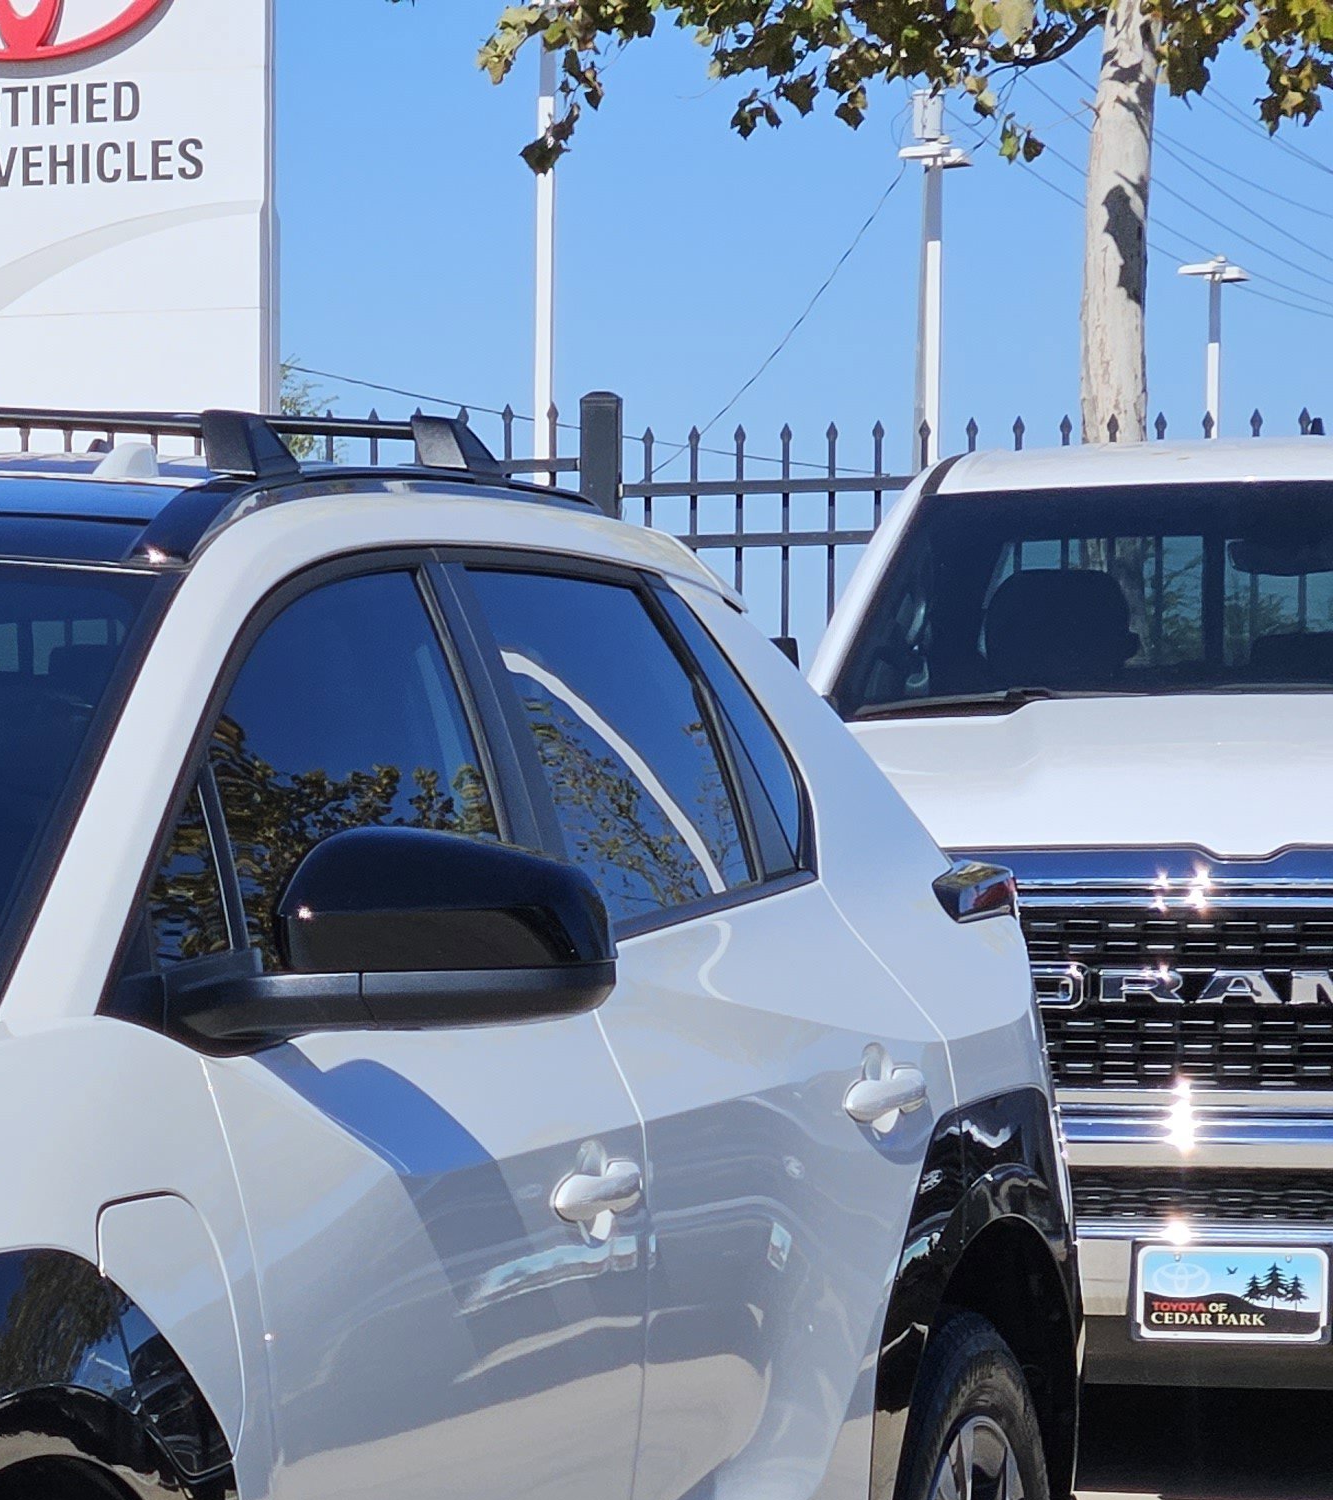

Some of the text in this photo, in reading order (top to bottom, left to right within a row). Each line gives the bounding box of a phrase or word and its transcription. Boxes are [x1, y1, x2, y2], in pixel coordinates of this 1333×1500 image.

[1152, 1301, 1228, 1313] TOYOTA OF
[1150, 1311, 1266, 1327] CEDAR PARK
